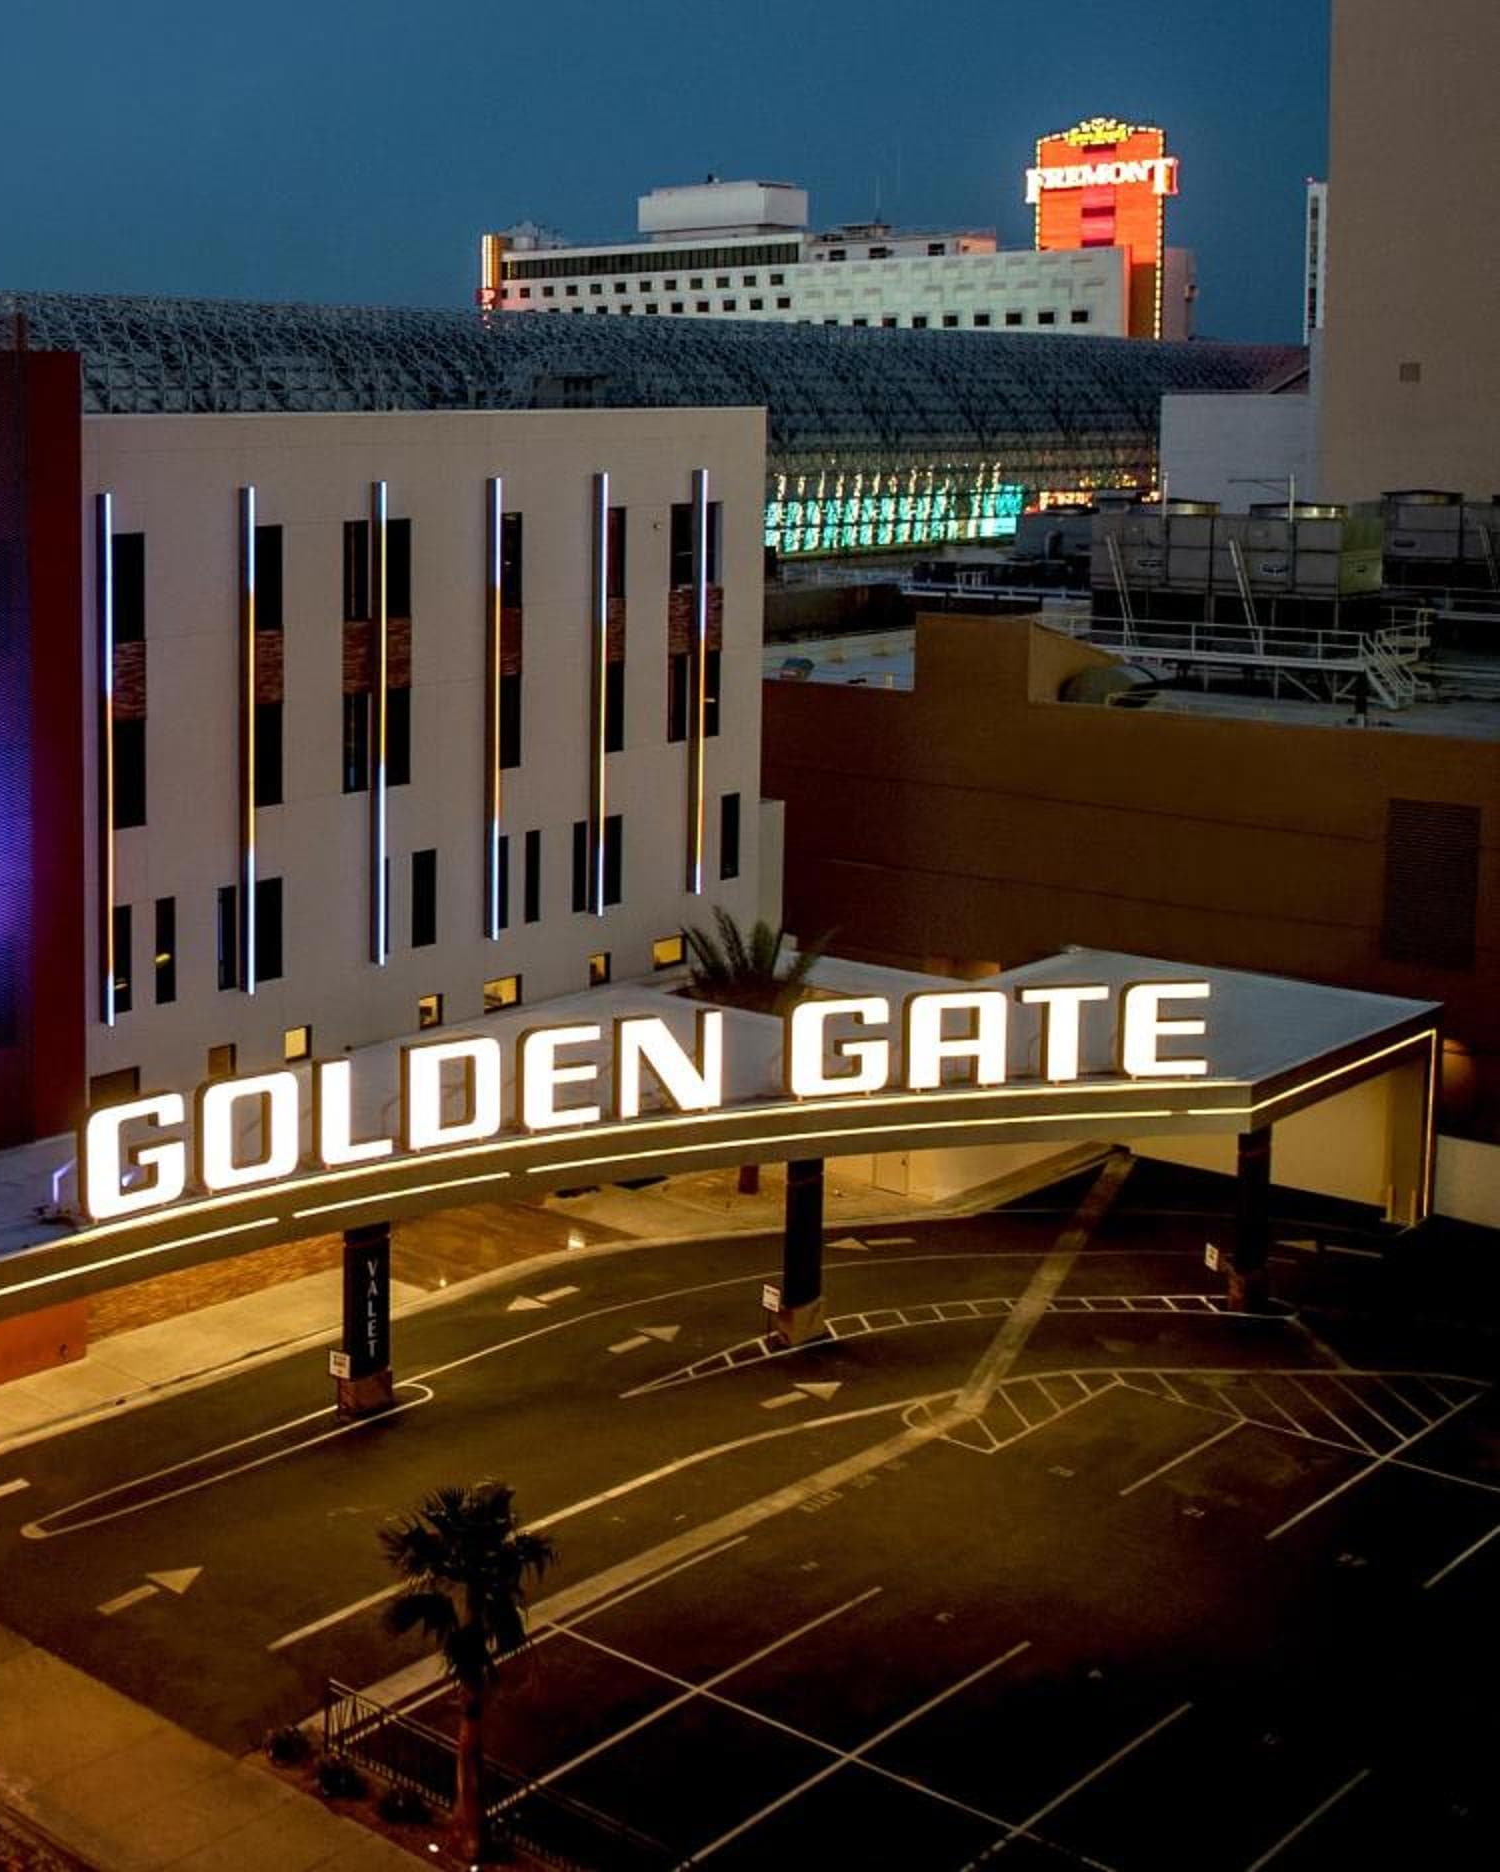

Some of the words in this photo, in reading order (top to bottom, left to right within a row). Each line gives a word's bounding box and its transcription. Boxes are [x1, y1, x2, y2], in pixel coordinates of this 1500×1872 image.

[1025, 157, 1178, 204] FREMONT
[82, 1008, 723, 1221] GOLDEN
[789, 982, 1211, 1098] GATE
[366, 1257, 379, 1359] VALET
